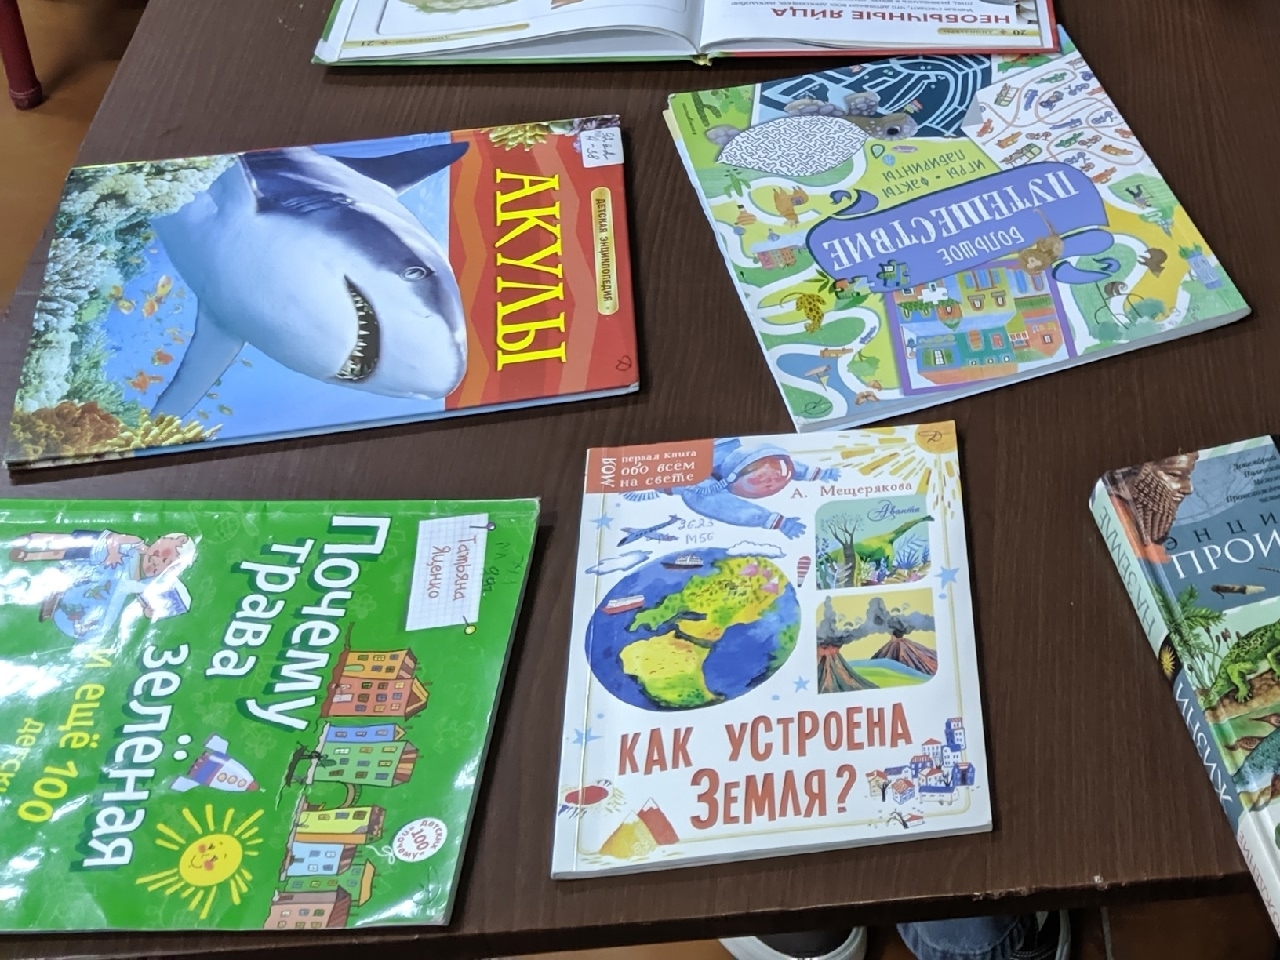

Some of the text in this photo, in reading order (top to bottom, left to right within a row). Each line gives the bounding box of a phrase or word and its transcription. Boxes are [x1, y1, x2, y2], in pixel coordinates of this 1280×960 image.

[770, 6, 843, 21] ЯЙЦА
[852, 10, 1010, 25] НЕОБЫЧНЫЕ
[595, 198, 614, 303] ДЕТСКАЯ ЭНЦИКЛОПЕДИЯ
[821, 169, 1080, 272] ПУТЕШЕСТВИЕ
[935, 225, 1025, 267] БОЛЬШОЕ
[494, 167, 567, 372] АКУЛЫ
[600, 457, 617, 488] МОЯ
[620, 459, 695, 477] обо всём
[620, 472, 694, 488] на свете
[621, 450, 697, 467] первая книга
[789, 479, 913, 500] А. Мещерякова
[426, 545, 452, 600] Яценко
[453, 534, 478, 602] Татьяна
[204, 536, 316, 679] трава
[246, 514, 393, 732] Почему
[57, 683, 107, 749] ещё
[618, 702, 914, 776] КАК УСТРОЕНА
[1173, 680, 1235, 805] ЖИЗНИ
[82, 643, 194, 868] зелёная
[18, 760, 79, 823] 100
[411, 827, 429, 851] 100
